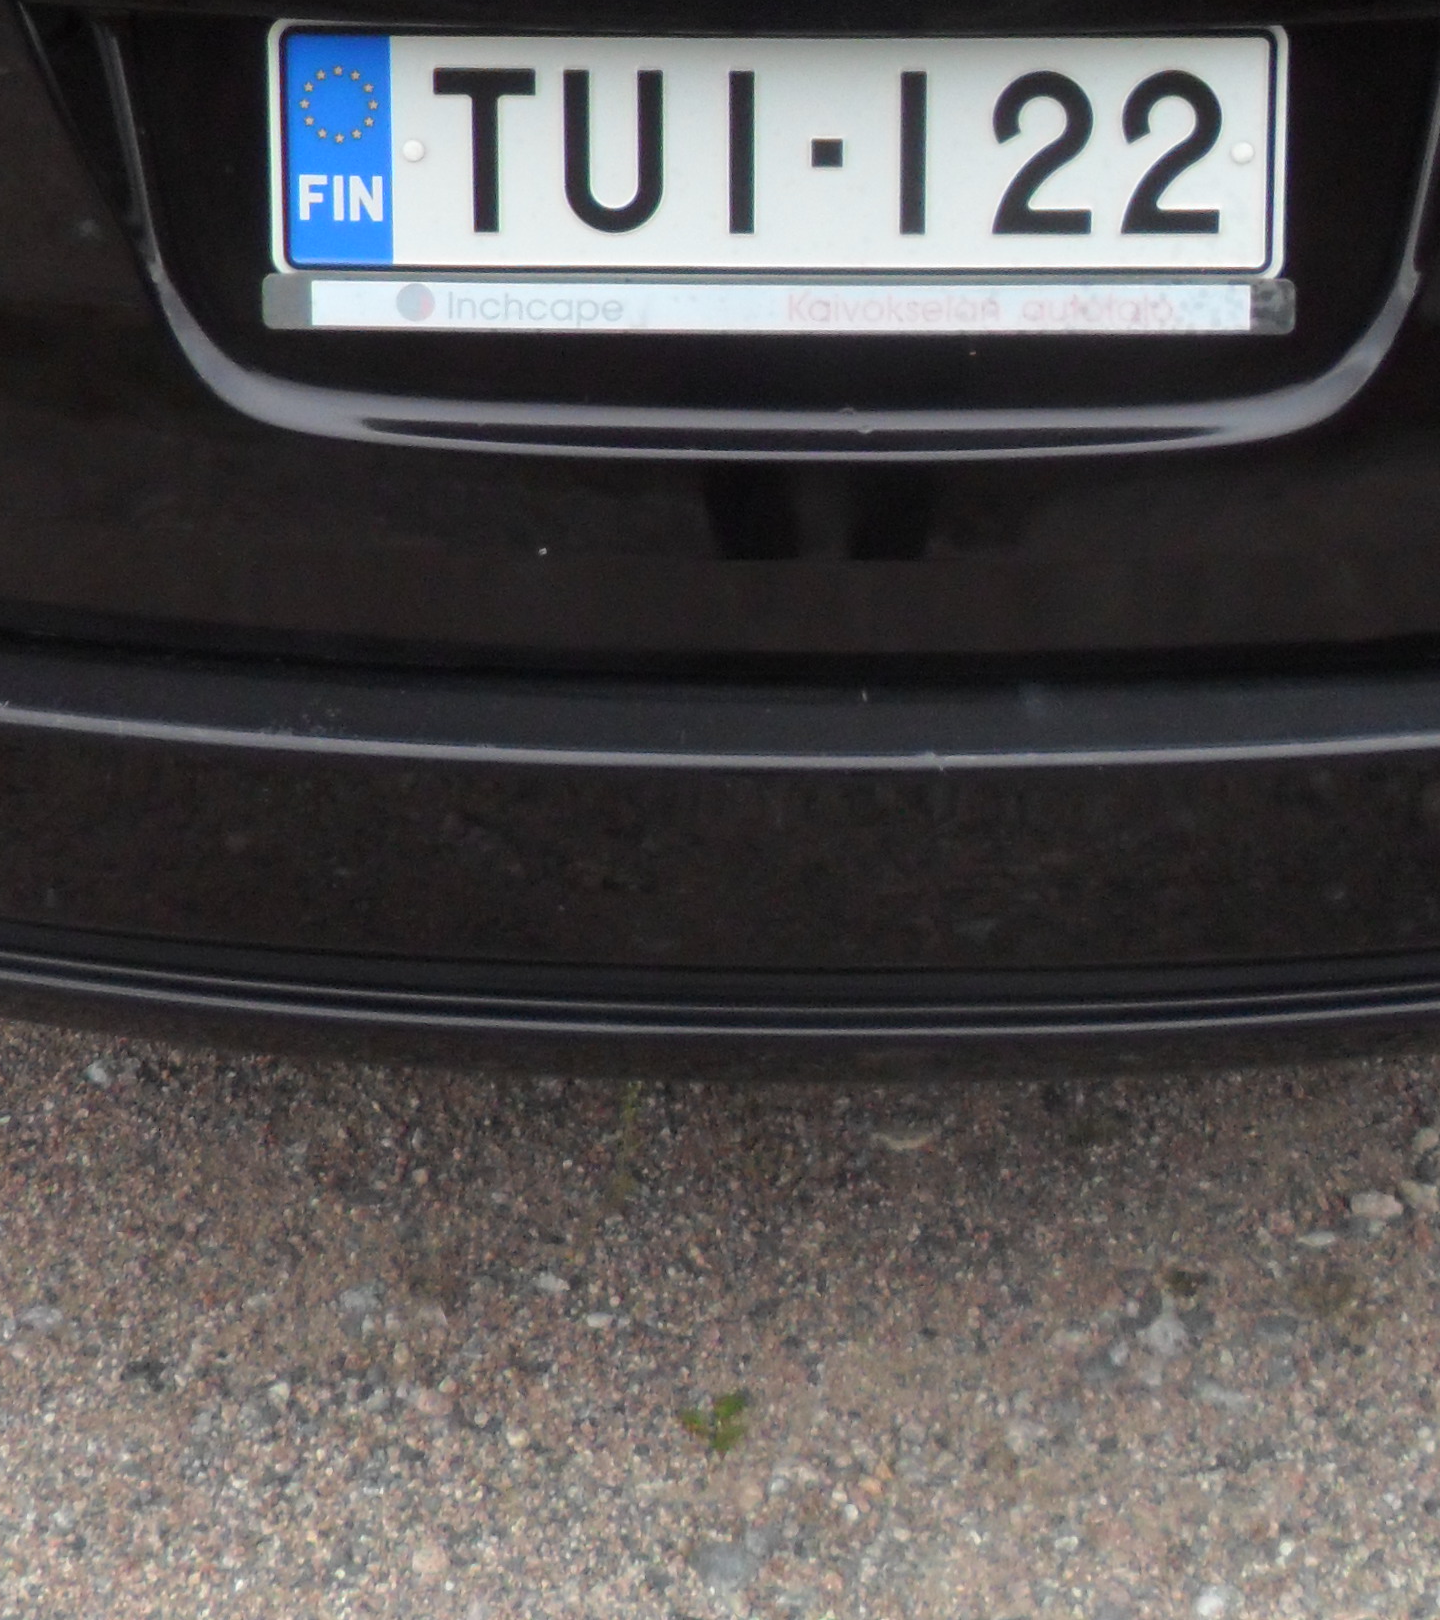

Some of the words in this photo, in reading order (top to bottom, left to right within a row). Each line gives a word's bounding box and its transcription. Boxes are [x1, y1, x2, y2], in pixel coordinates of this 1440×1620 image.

[432, 67, 1224, 236] TUI-122
[298, 173, 384, 223] FIN
[448, 291, 624, 325] Inchcape
[786, 293, 1000, 324] Kaivokselan
